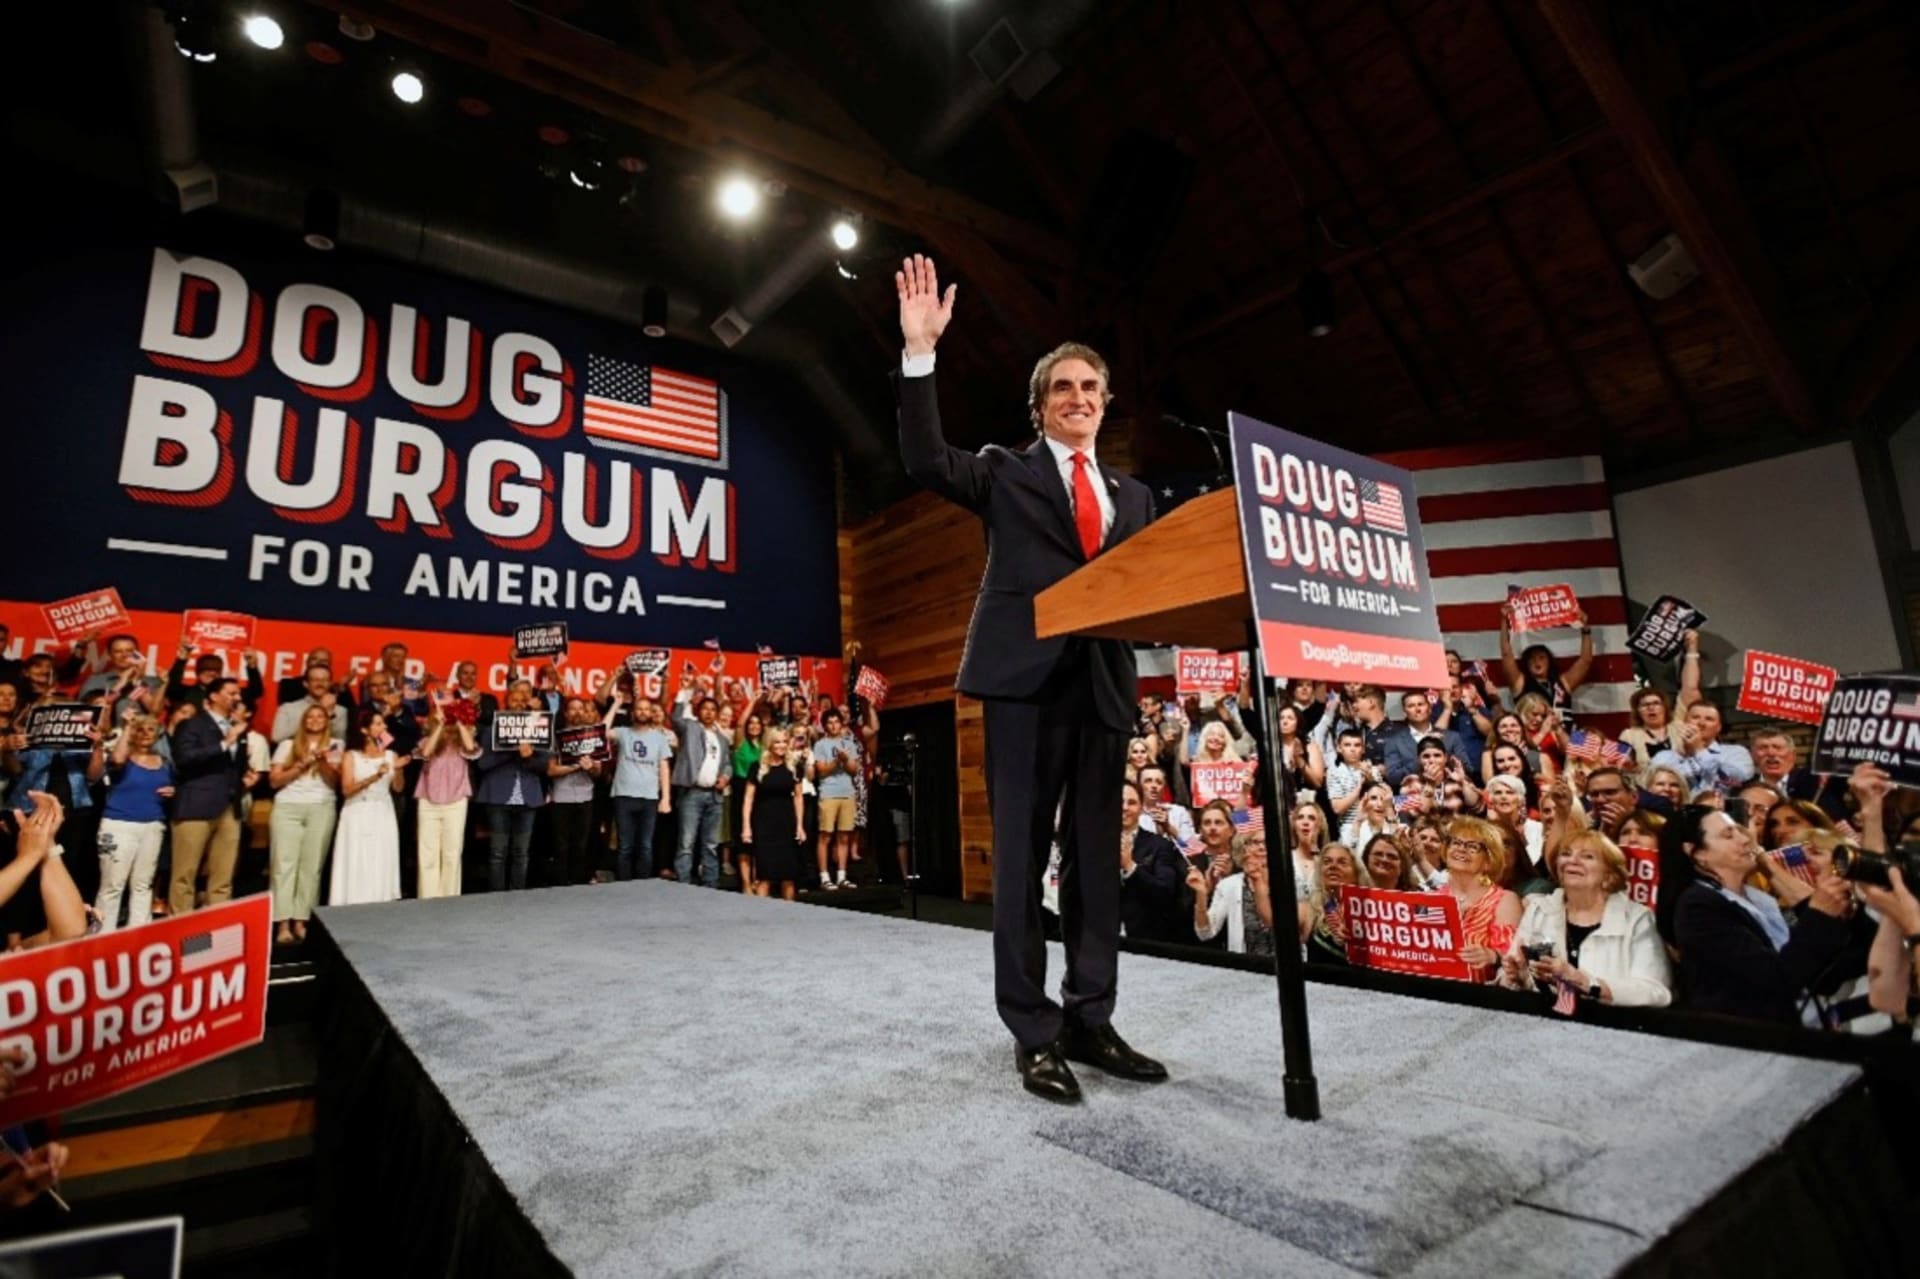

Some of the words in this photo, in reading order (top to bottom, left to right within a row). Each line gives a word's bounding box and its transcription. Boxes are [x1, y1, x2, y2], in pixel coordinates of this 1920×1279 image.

[140, 247, 563, 427] DOUG
[118, 374, 728, 564] BURGUM
[1251, 443, 1360, 520] DOUG
[1260, 505, 1416, 586] BURGUM
[249, 534, 373, 591] FOR
[404, 552, 646, 616] AMERICA
[49, 599, 92, 619] DOUG
[1301, 580, 1330, 606] FOR
[1337, 587, 1400, 617] AMERICA
[55, 604, 118, 630] BURGUM
[1300, 640, 1420, 671] DougBurgum.com
[1753, 660, 1805, 682] DOUG
[1830, 689, 1892, 716] DOUG
[1848, 748, 1901, 766] AMERICA
[1348, 896, 1411, 923] DOUG
[1352, 919, 1453, 950] BURGUM
[1369, 945, 1388, 957] FOR
[1391, 948, 1437, 963] AMERICA
[0, 942, 173, 1032] DOUG
[47, 1062, 95, 1092] FOR
[107, 1021, 207, 1073] AMERICA
